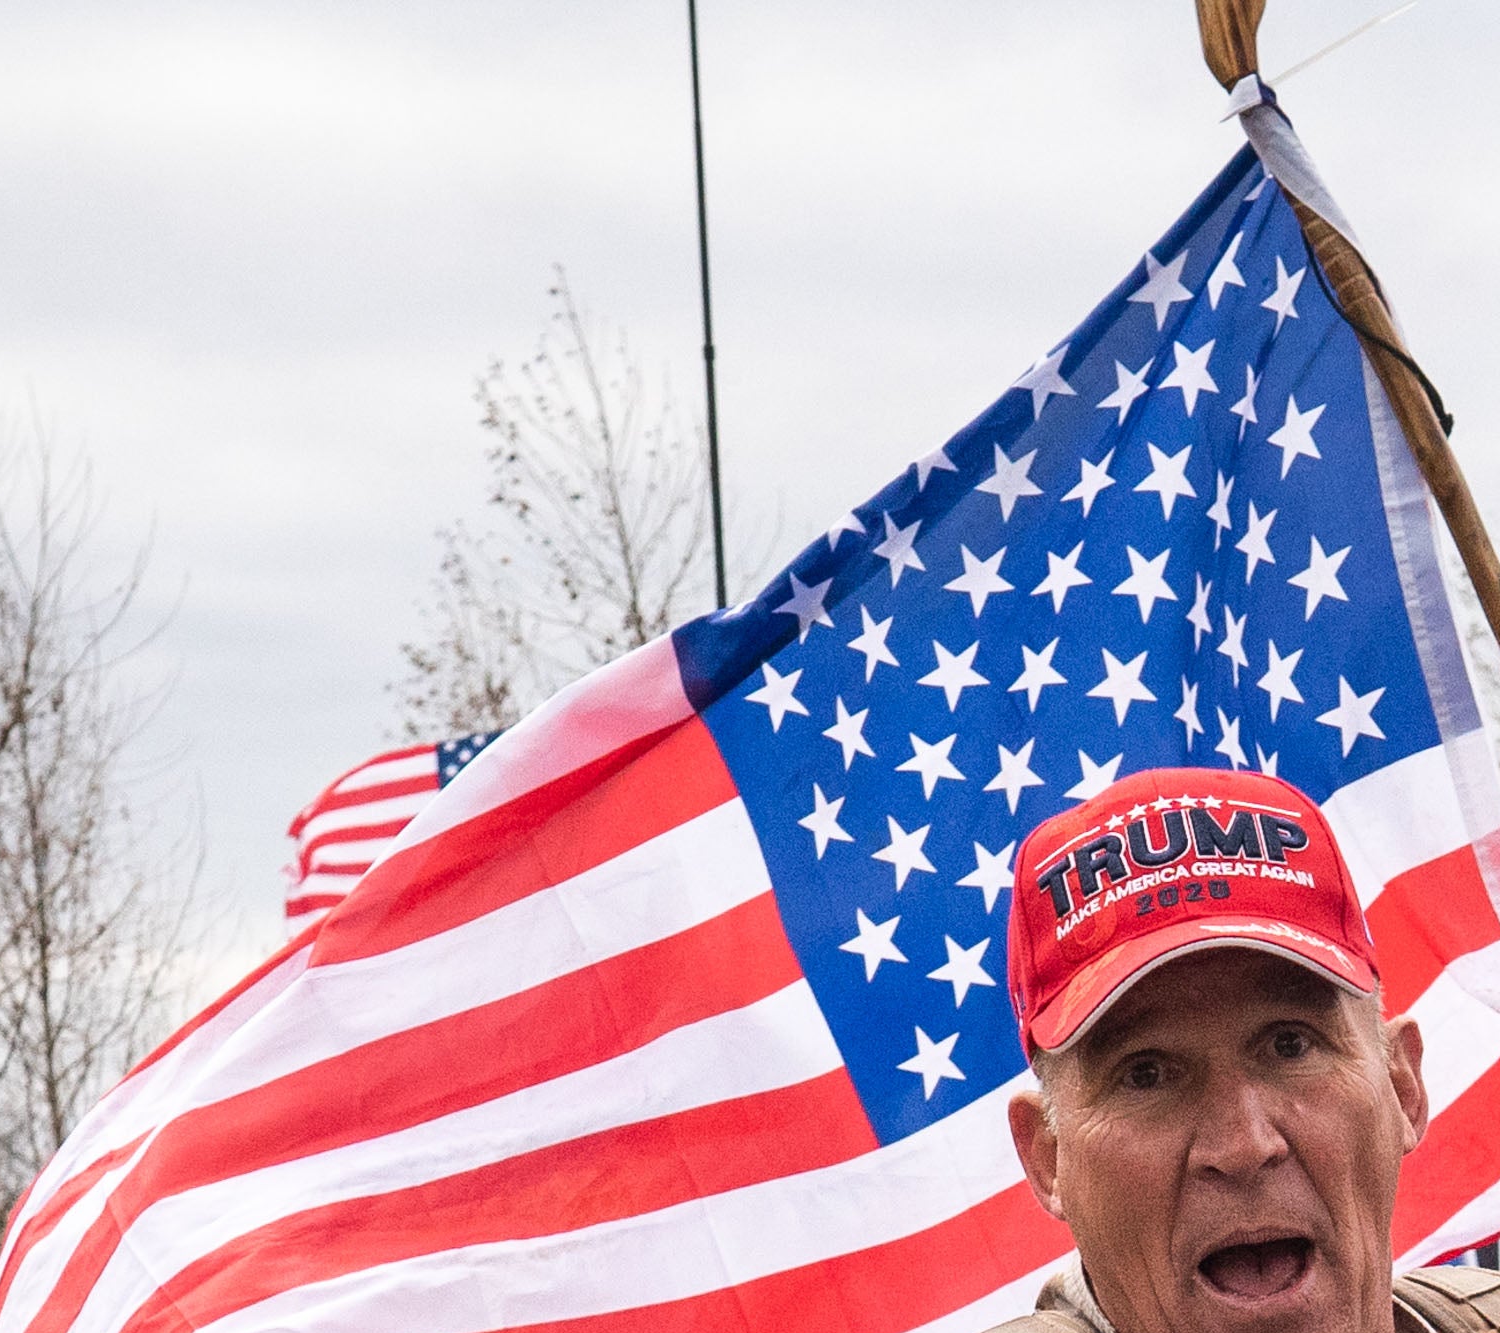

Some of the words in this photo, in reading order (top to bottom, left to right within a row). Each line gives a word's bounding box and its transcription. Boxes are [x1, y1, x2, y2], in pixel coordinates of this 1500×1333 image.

[1036, 806, 1310, 922] TRUMP
[1054, 901, 1102, 942] MAKE
[1103, 864, 1191, 908] AMERICA
[1191, 859, 1257, 879] GREAT
[1259, 863, 1316, 889] AGAIN
[1135, 878, 1231, 917] 2020
